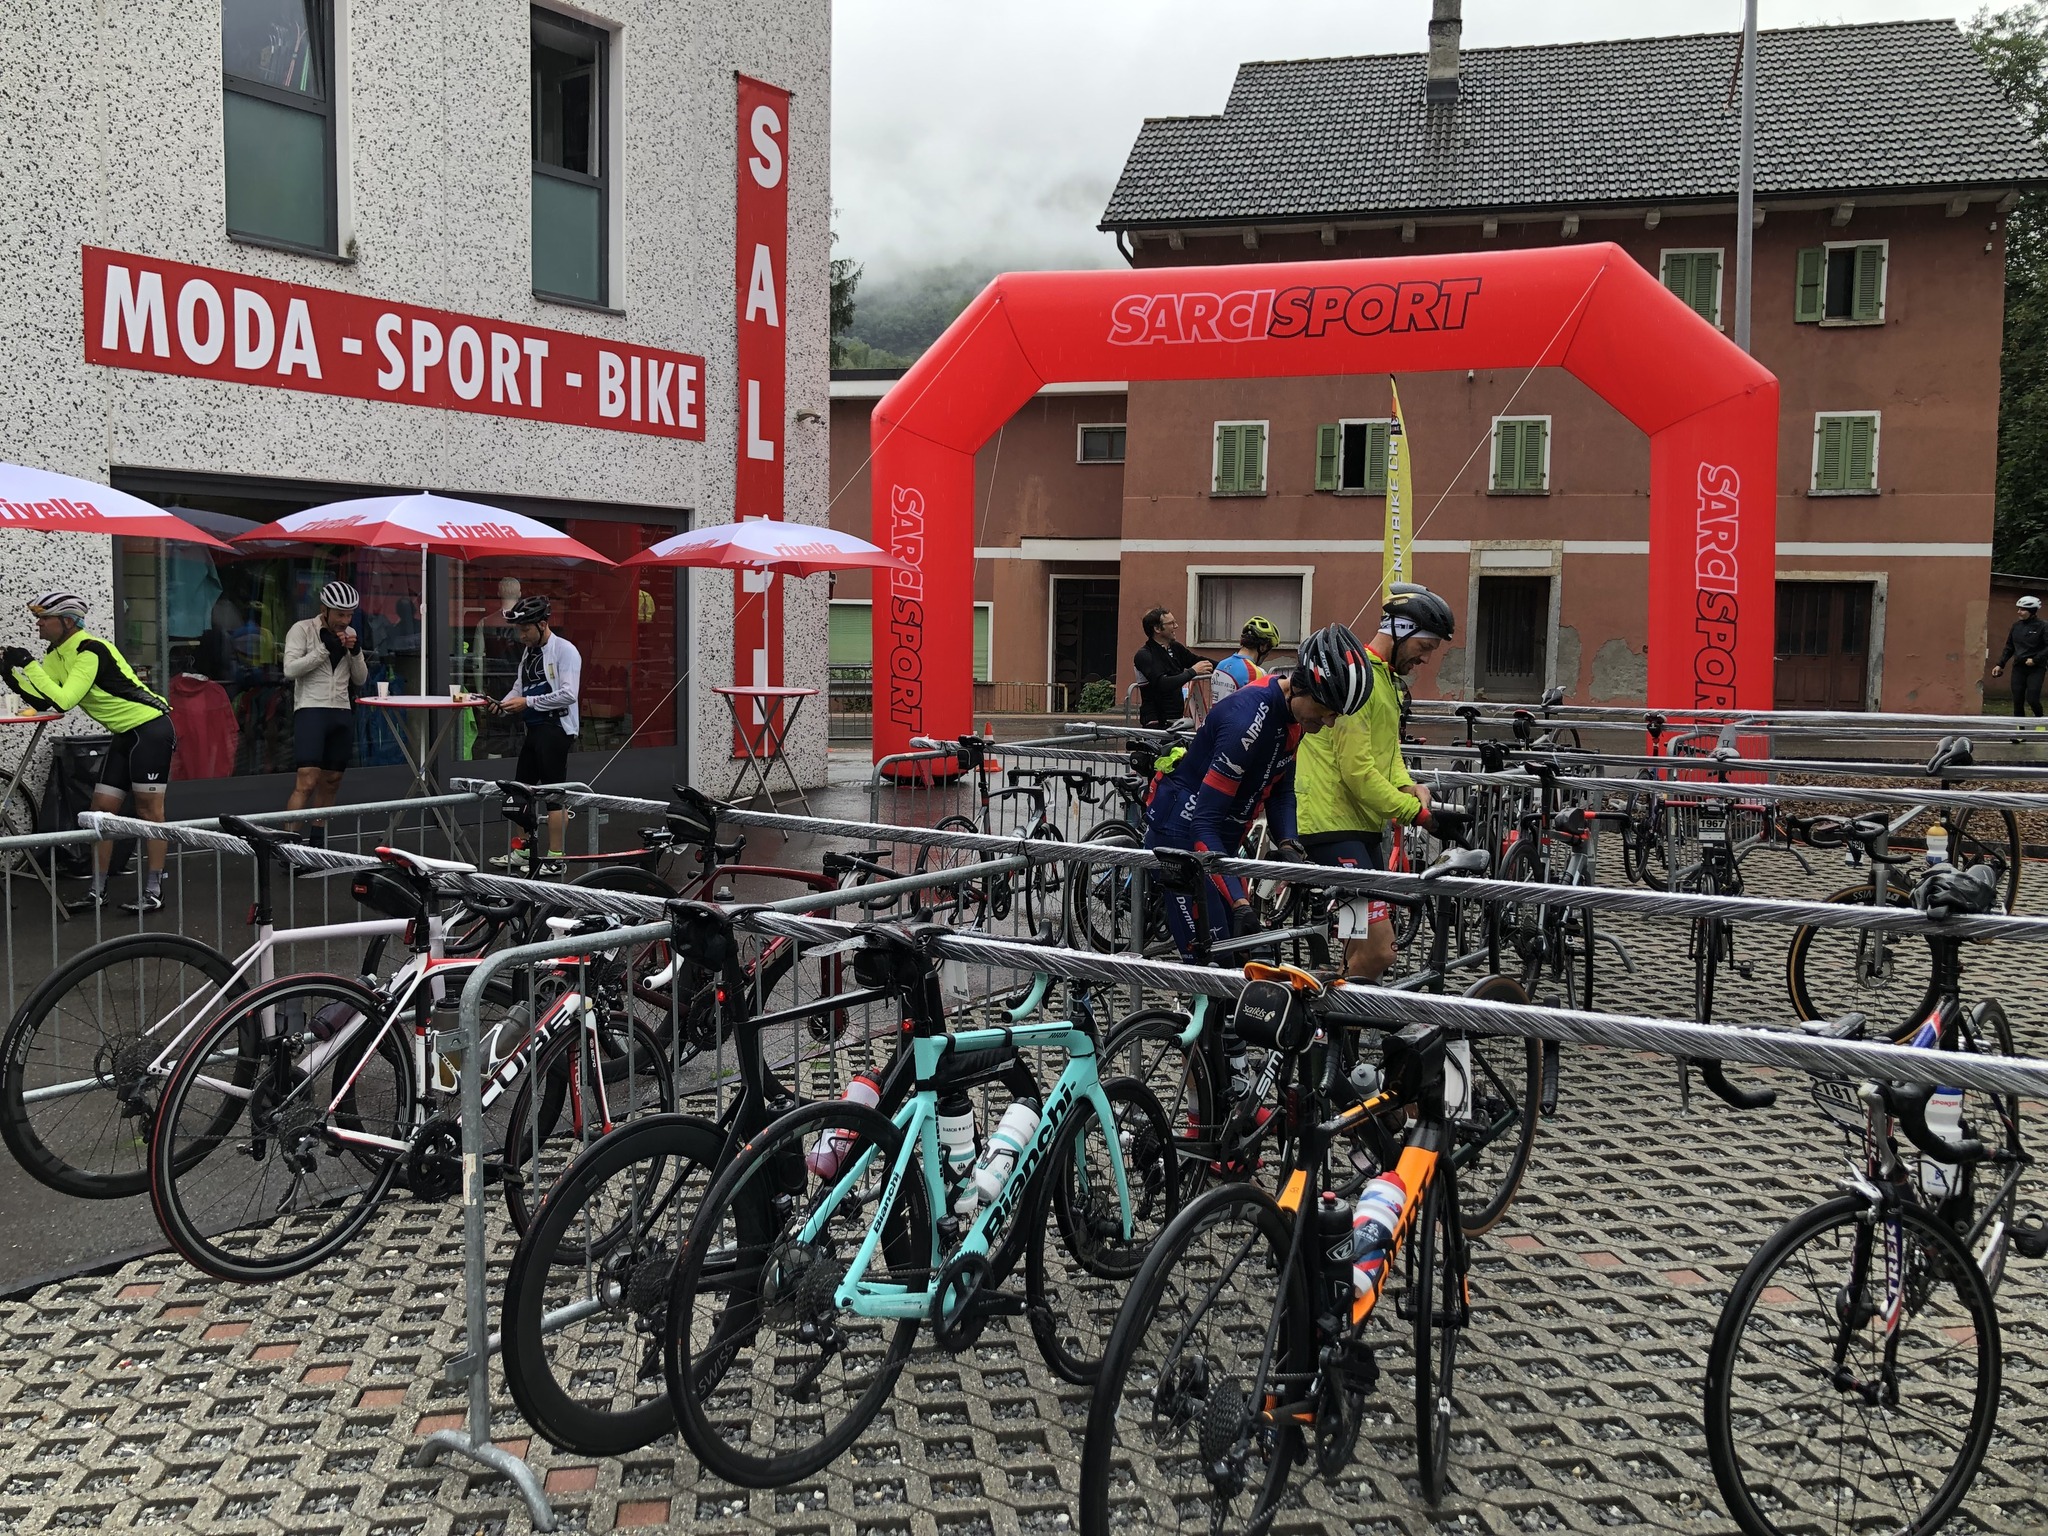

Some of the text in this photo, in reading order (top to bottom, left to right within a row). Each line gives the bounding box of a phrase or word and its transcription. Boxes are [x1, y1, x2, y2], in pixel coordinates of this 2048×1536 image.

[101, 264, 323, 380] MODA
[377, 313, 550, 408] SPORT
[598, 350, 699, 430] BIKE
[437, 521, 522, 539] rivella
[772, 542, 845, 557] rivella
[1694, 461, 1740, 725] SARCISPOR
[1241, 702, 1269, 752] AIRBUS
[1700, 820, 1724, 828] 1967
[982, 1082, 1072, 1246] Bianchi
[873, 1171, 901, 1234] Bianchi
[1886, 1222, 1900, 1299] TREK
[698, 1344, 734, 1395] SWISS
